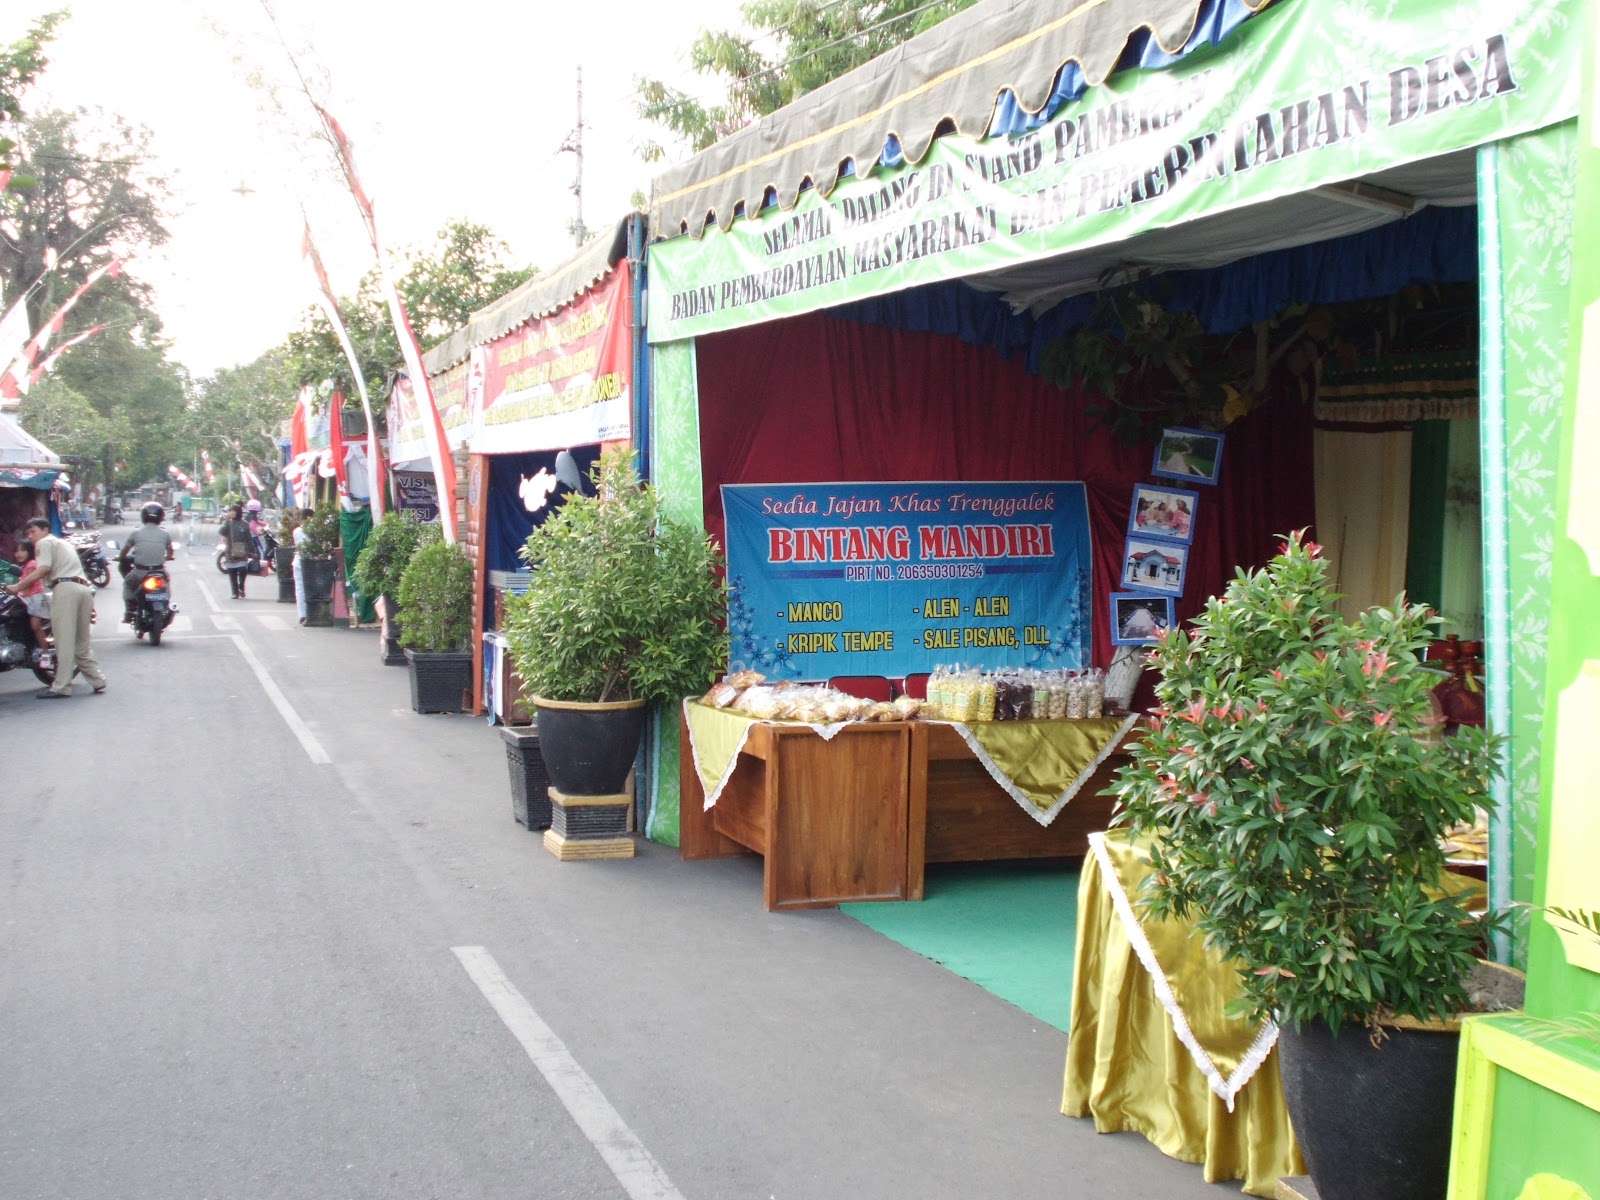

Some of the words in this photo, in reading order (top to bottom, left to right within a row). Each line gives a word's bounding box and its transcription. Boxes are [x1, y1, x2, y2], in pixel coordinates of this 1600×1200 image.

[670, 284, 717, 321] BADAN
[720, 245, 847, 310] PEMBERDAYAAN
[852, 202, 997, 276] MASYARAKAT
[1009, 182, 1069, 236] DAN
[1075, 78, 1370, 219] PEMERINTAHAN
[1387, 33, 1521, 128] DESA
[763, 202, 837, 256] SELAMAT
[842, 171, 921, 228] DATANG
[928, 160, 954, 202] DI
[962, 131, 1043, 193] STAND
[399, 477, 428, 488] VISI
[761, 495, 818, 515] Sedia
[822, 495, 882, 520] Jajan
[887, 493, 940, 513] Khas
[948, 492, 1055, 520] Trenggalek
[768, 526, 910, 563] BINTANG
[919, 524, 1055, 560] MANDIRI
[846, 566, 872, 582] PIRT
[875, 565, 895, 580] NO.
[897, 564, 984, 581] 206350301254
[787, 602, 843, 622] MANCO
[923, 599, 960, 619] ALEN
[974, 596, 1010, 617] ALEN
[787, 633, 839, 654] KRIPIK
[843, 631, 894, 652] TEMPE
[923, 629, 961, 649] SALE
[963, 627, 1020, 649] PISANG,
[1024, 626, 1051, 646] DLL
